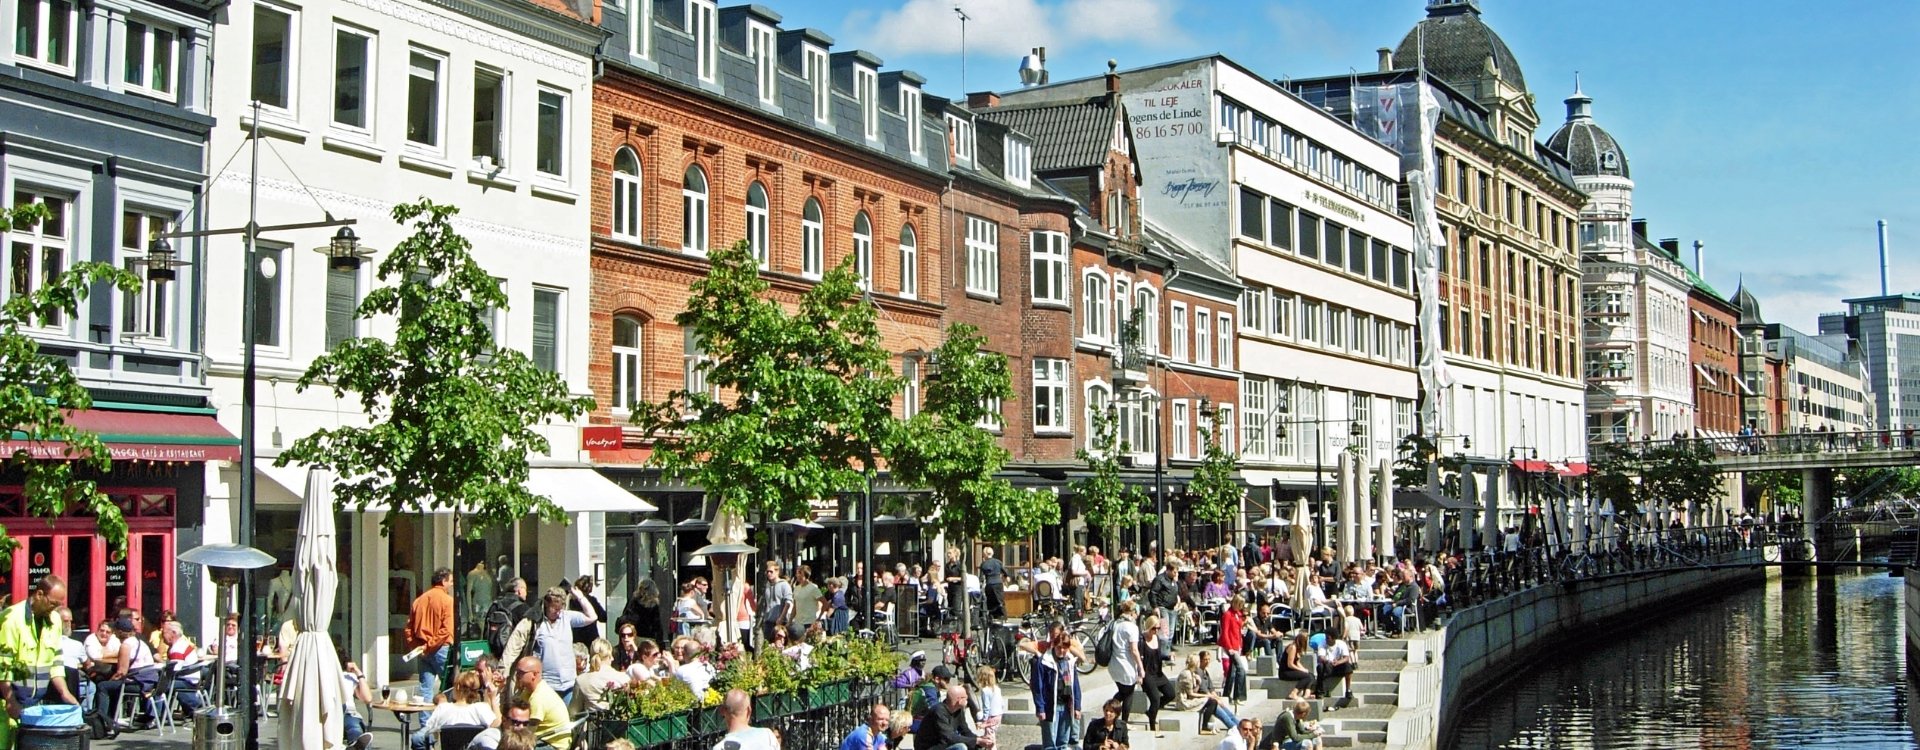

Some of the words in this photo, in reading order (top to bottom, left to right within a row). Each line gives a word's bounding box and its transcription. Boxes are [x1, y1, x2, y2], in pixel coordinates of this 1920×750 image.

[1144, 98, 1156, 107] TIL
[1161, 96, 1179, 108] LEJE
[1128, 113, 1158, 124] ogens
[1159, 110, 1171, 120] de
[1173, 107, 1202, 119] Linde
[1136, 126, 1151, 140] 86
[1155, 124, 1167, 138] 16
[1170, 123, 1184, 137] 57
[1187, 121, 1203, 135] 00
[166, 450, 205, 458] RESTAURANT
